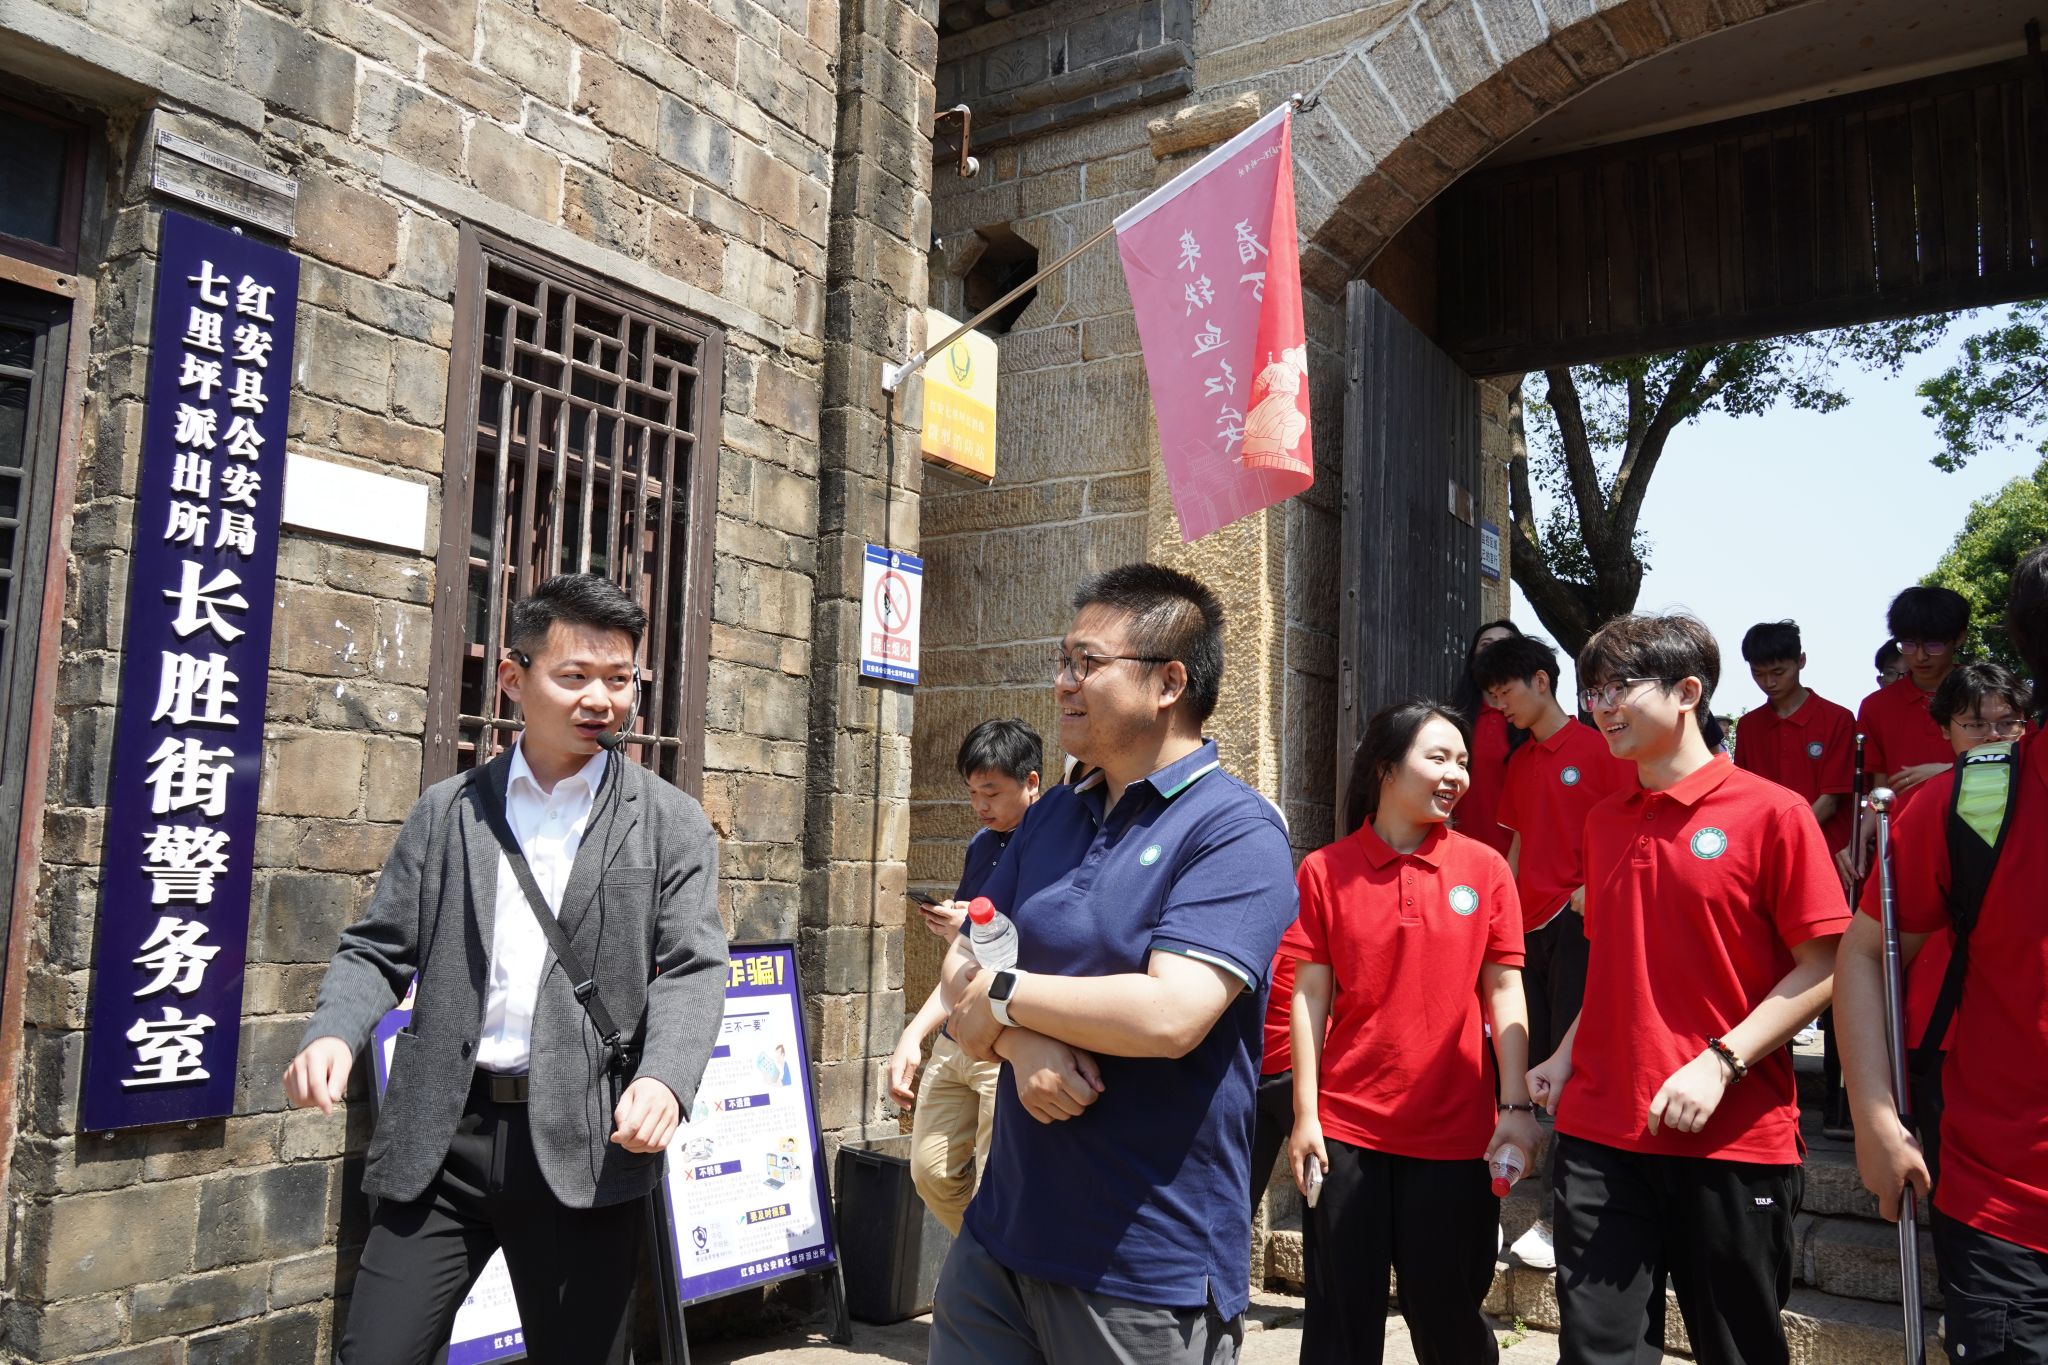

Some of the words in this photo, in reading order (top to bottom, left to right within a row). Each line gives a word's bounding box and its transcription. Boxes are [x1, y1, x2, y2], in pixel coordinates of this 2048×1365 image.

[164, 260, 231, 547] 七里坪派出所
[214, 274, 276, 556] 红安县公安局
[872, 637, 909, 658] 禁止烟火
[121, 559, 249, 1089] 长胜街警务室
[740, 1248, 827, 1278] 红安县公安局七里坪派出所
